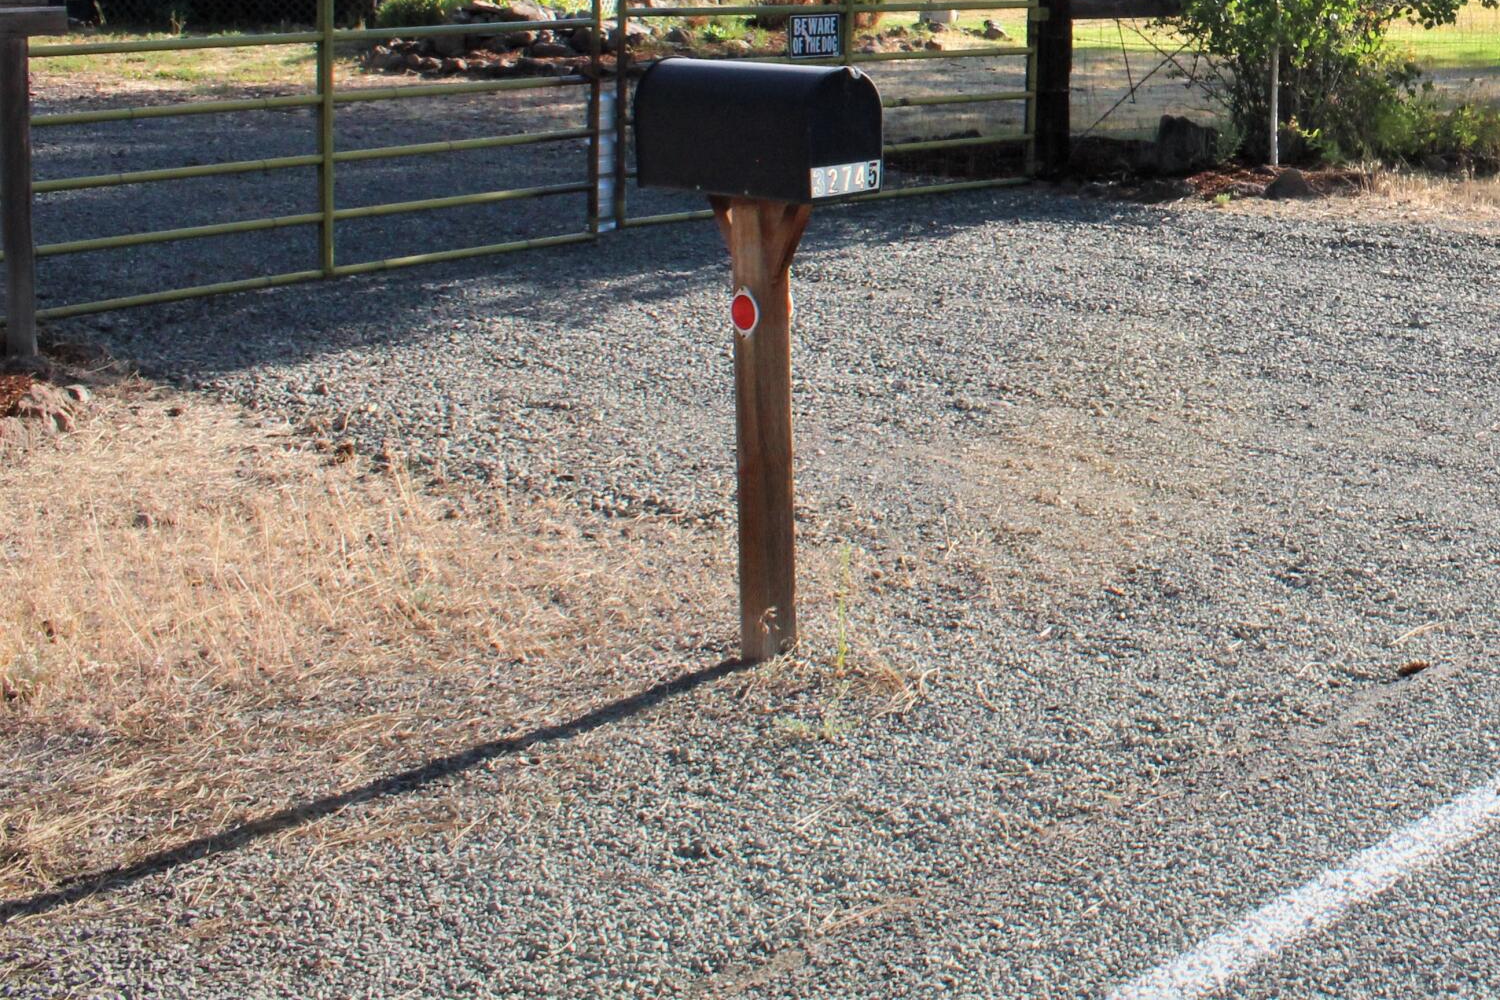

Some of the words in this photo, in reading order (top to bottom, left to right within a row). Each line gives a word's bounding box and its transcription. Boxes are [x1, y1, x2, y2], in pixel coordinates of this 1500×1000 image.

[793, 17, 836, 35] BEWARE
[793, 37, 803, 54] OF
[805, 36, 820, 53] THE
[821, 35, 837, 52] DOG
[811, 162, 878, 196] 32745
